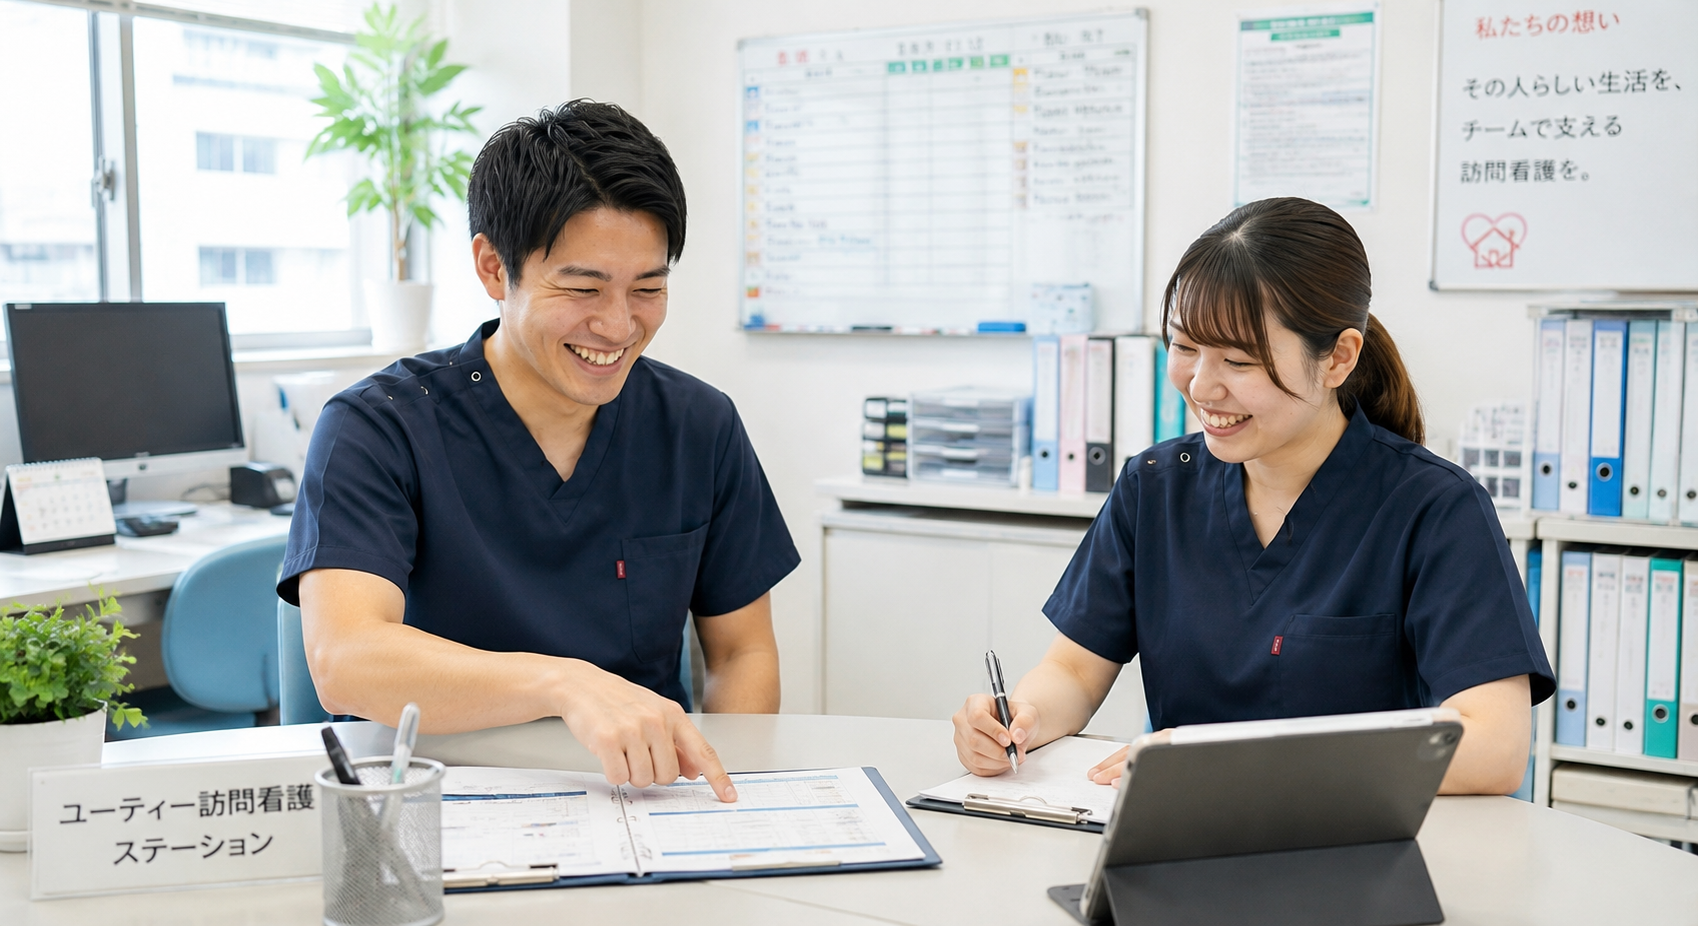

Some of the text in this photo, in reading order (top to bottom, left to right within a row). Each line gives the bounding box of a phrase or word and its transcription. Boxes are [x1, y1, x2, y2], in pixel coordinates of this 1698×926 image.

[1475, 9, 1620, 39] 私たちの想い
[1463, 68, 1682, 99] その人らしい生活を、
[1462, 115, 1623, 141] チームで支える
[1460, 159, 1591, 184] 訪問看護を。
[60, 783, 316, 825] ユーティー訪問看護
[113, 832, 274, 866] ステーション
